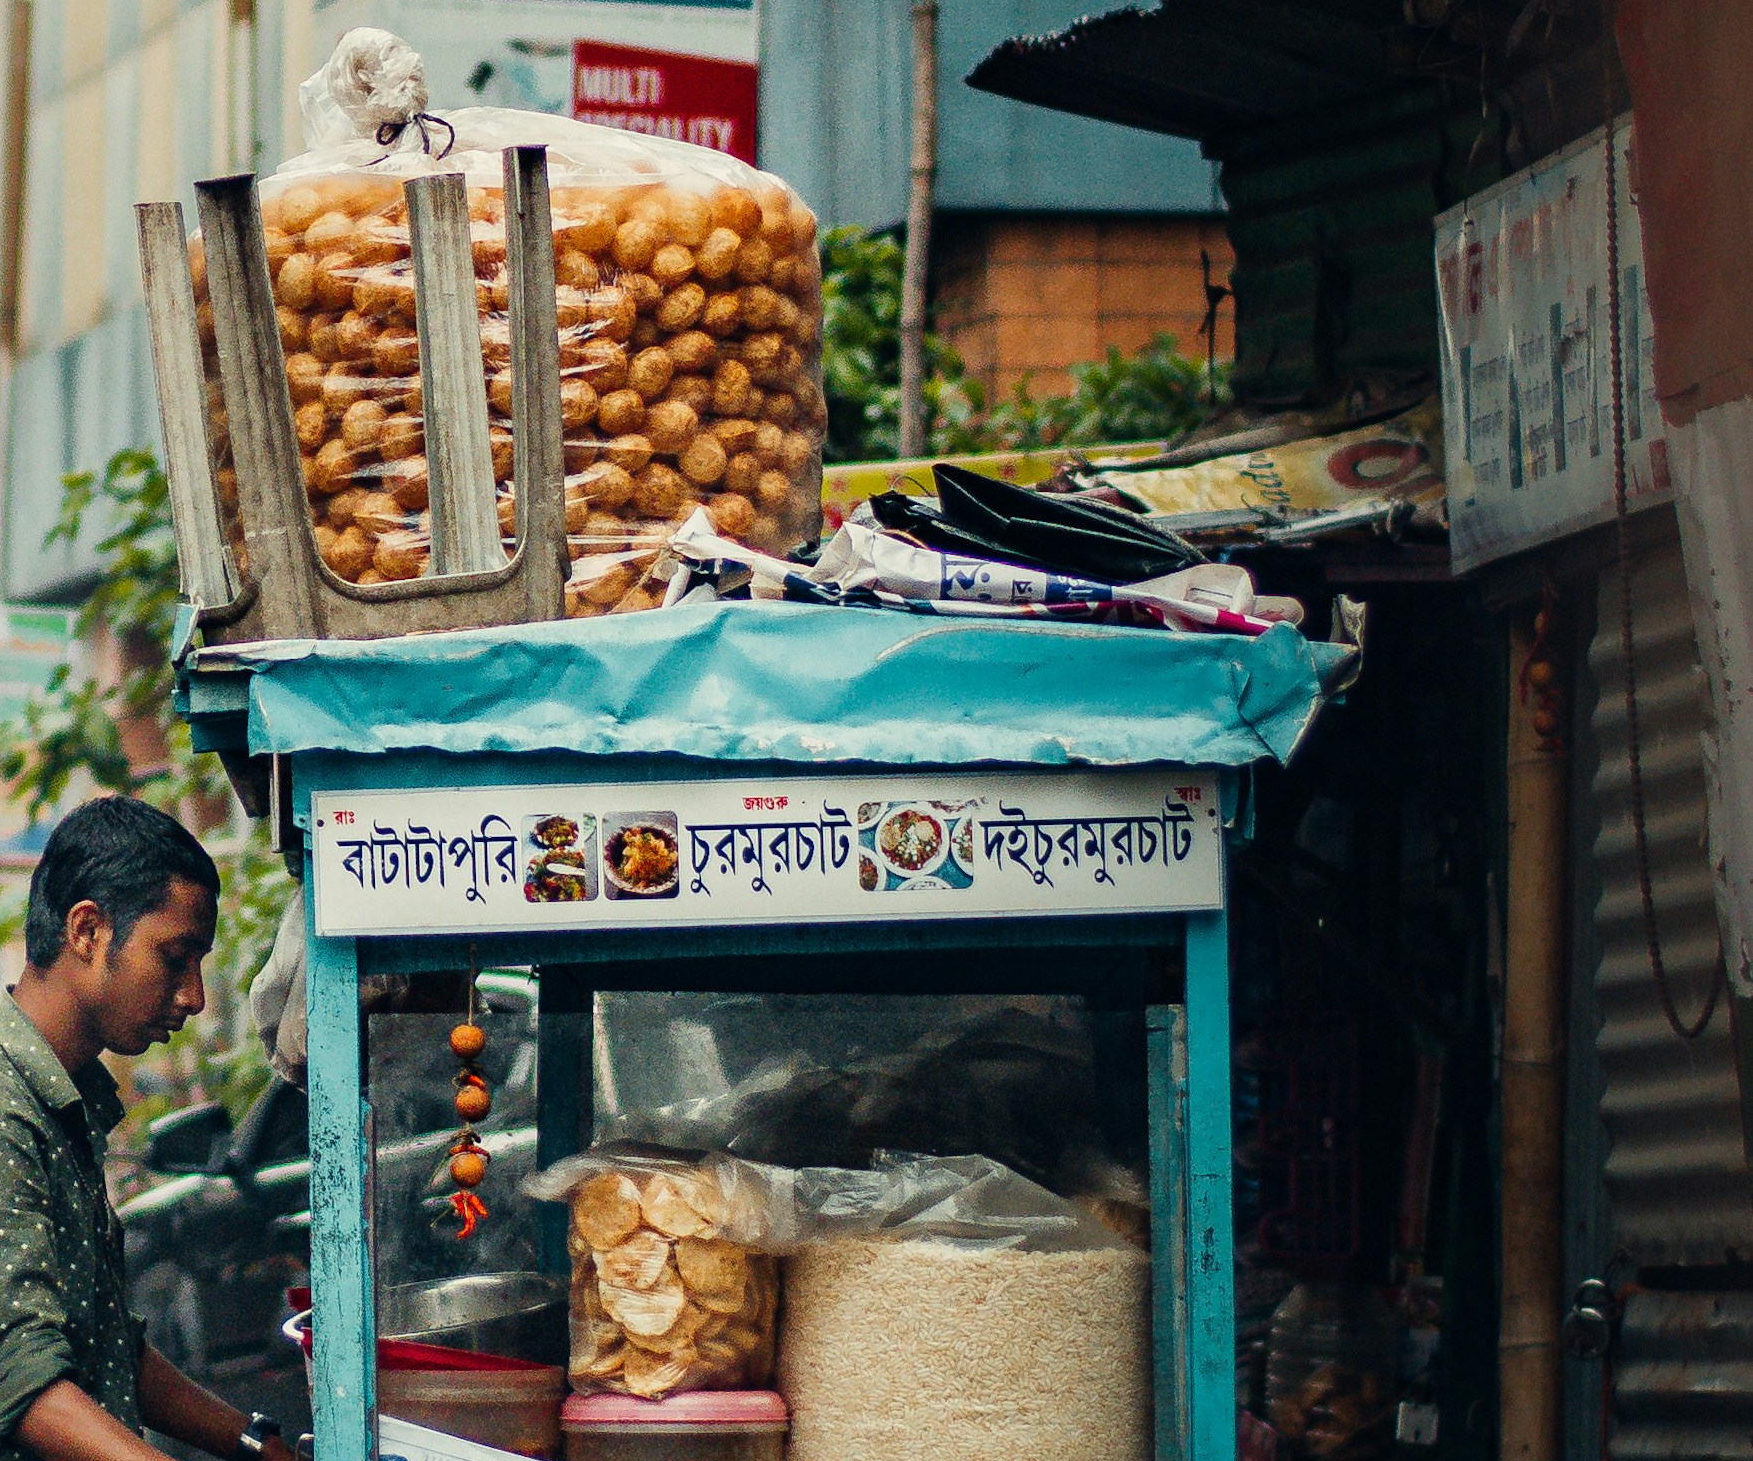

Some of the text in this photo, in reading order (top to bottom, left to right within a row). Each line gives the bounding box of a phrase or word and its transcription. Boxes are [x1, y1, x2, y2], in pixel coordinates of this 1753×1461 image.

[581, 67, 660, 104] MULTI
[580, 114, 734, 153] ALITY
[336, 795, 1195, 905] বাটাটাপুরি চুরমুরচাট দইচুরমুরচাট
